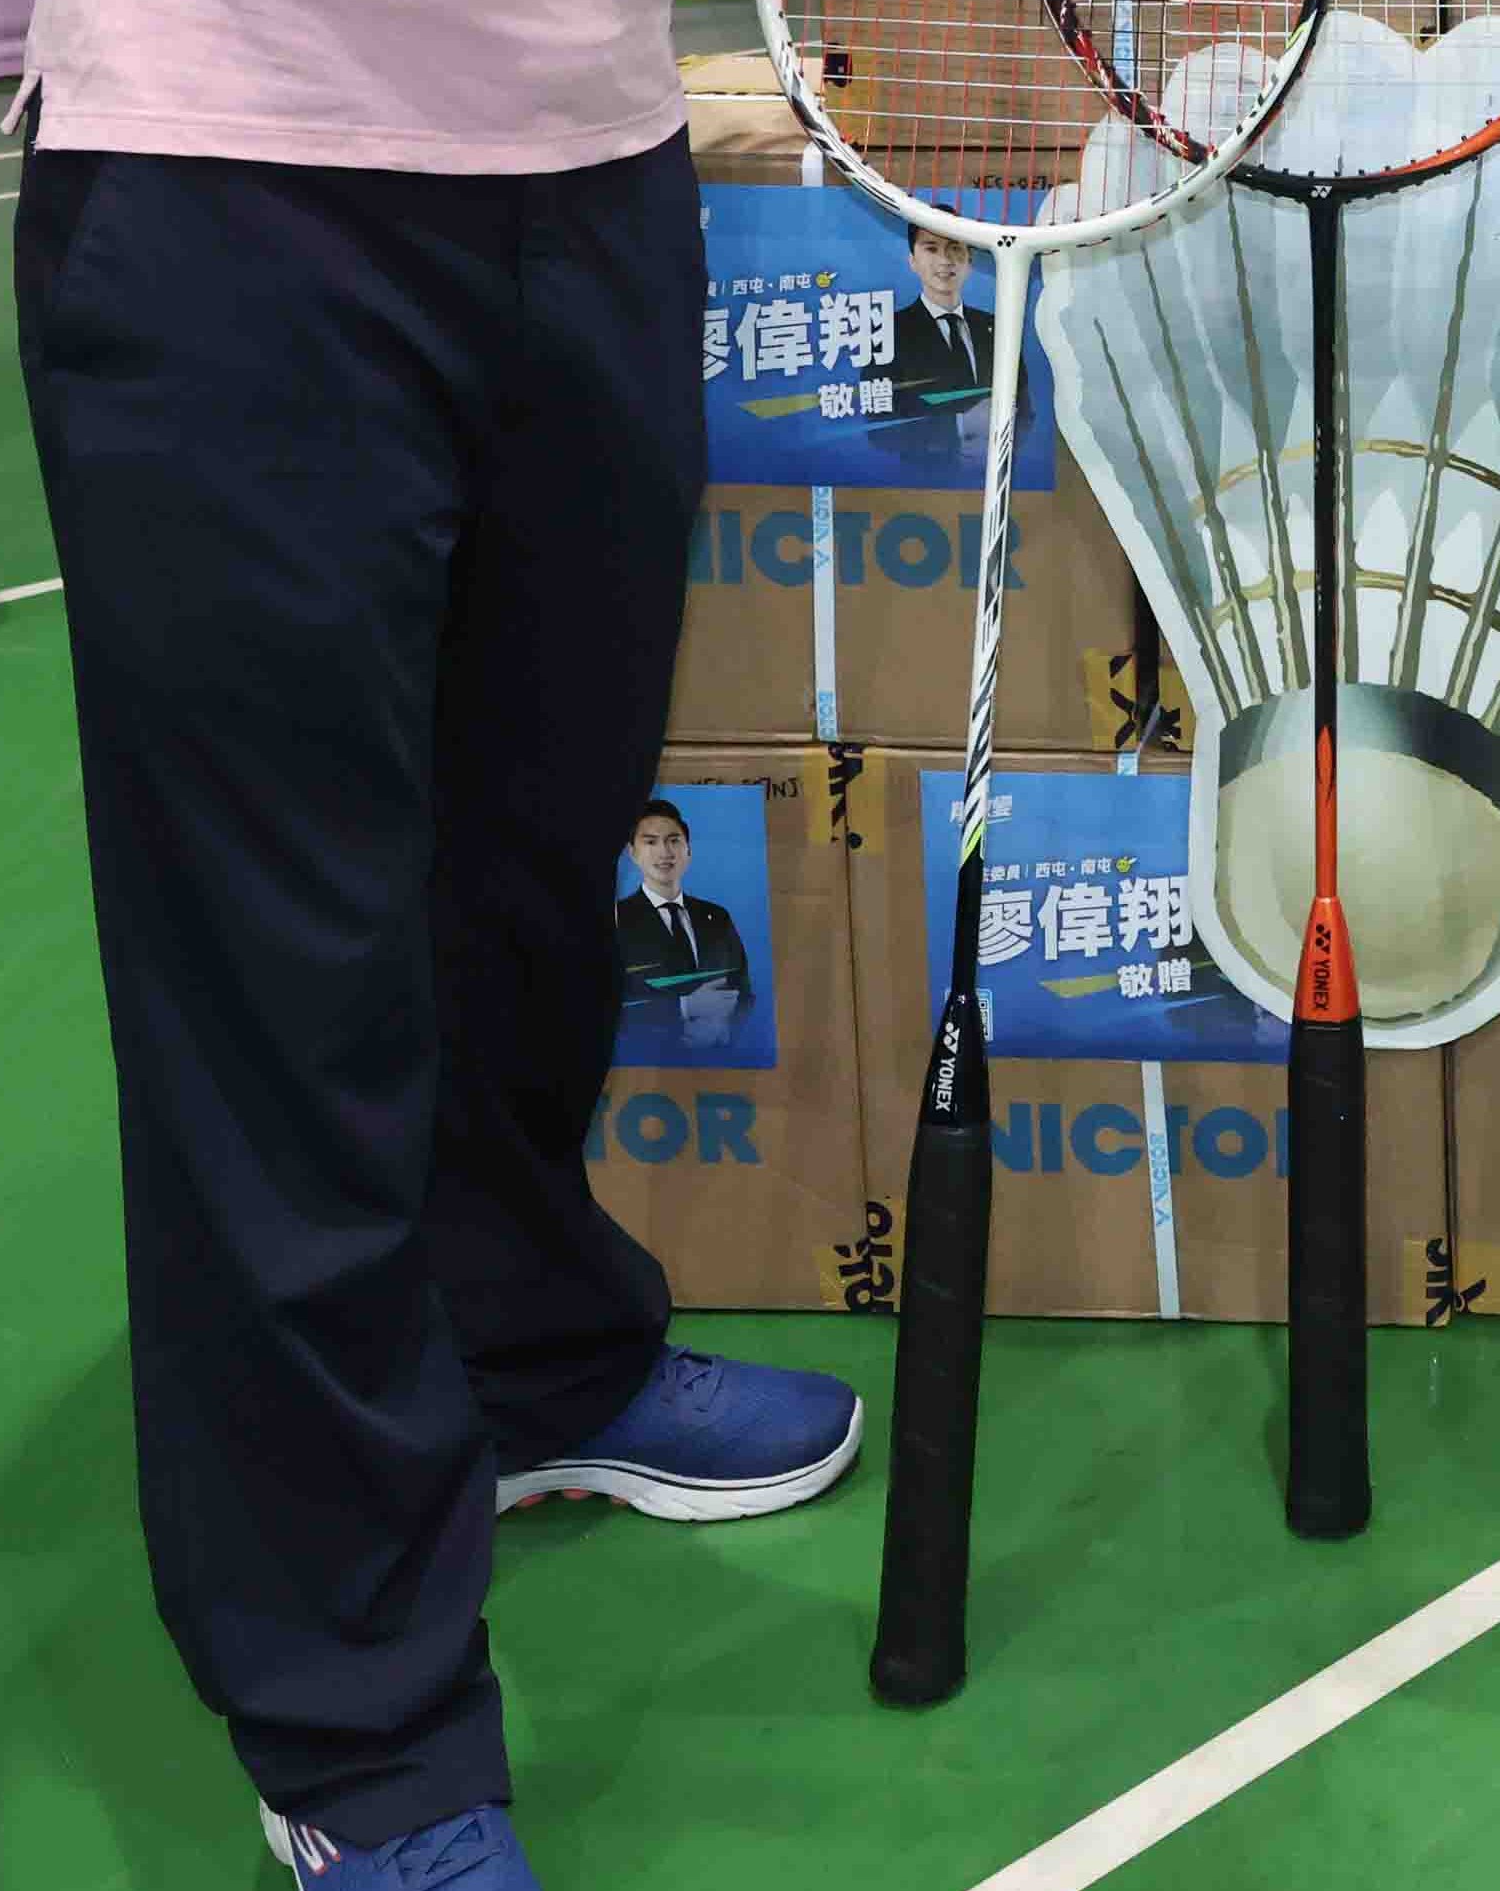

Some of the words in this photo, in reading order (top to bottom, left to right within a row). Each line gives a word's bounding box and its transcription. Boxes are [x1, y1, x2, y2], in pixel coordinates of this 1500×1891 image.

[817, 378, 894, 419] 敬贈
[976, 875, 1193, 967] 廖偉翔
[1117, 957, 1192, 999] 敬贈
[1312, 958, 1332, 1011] YONEX
[935, 1056, 956, 1113] YONEX
[990, 1102, 1290, 1178] VICTO
